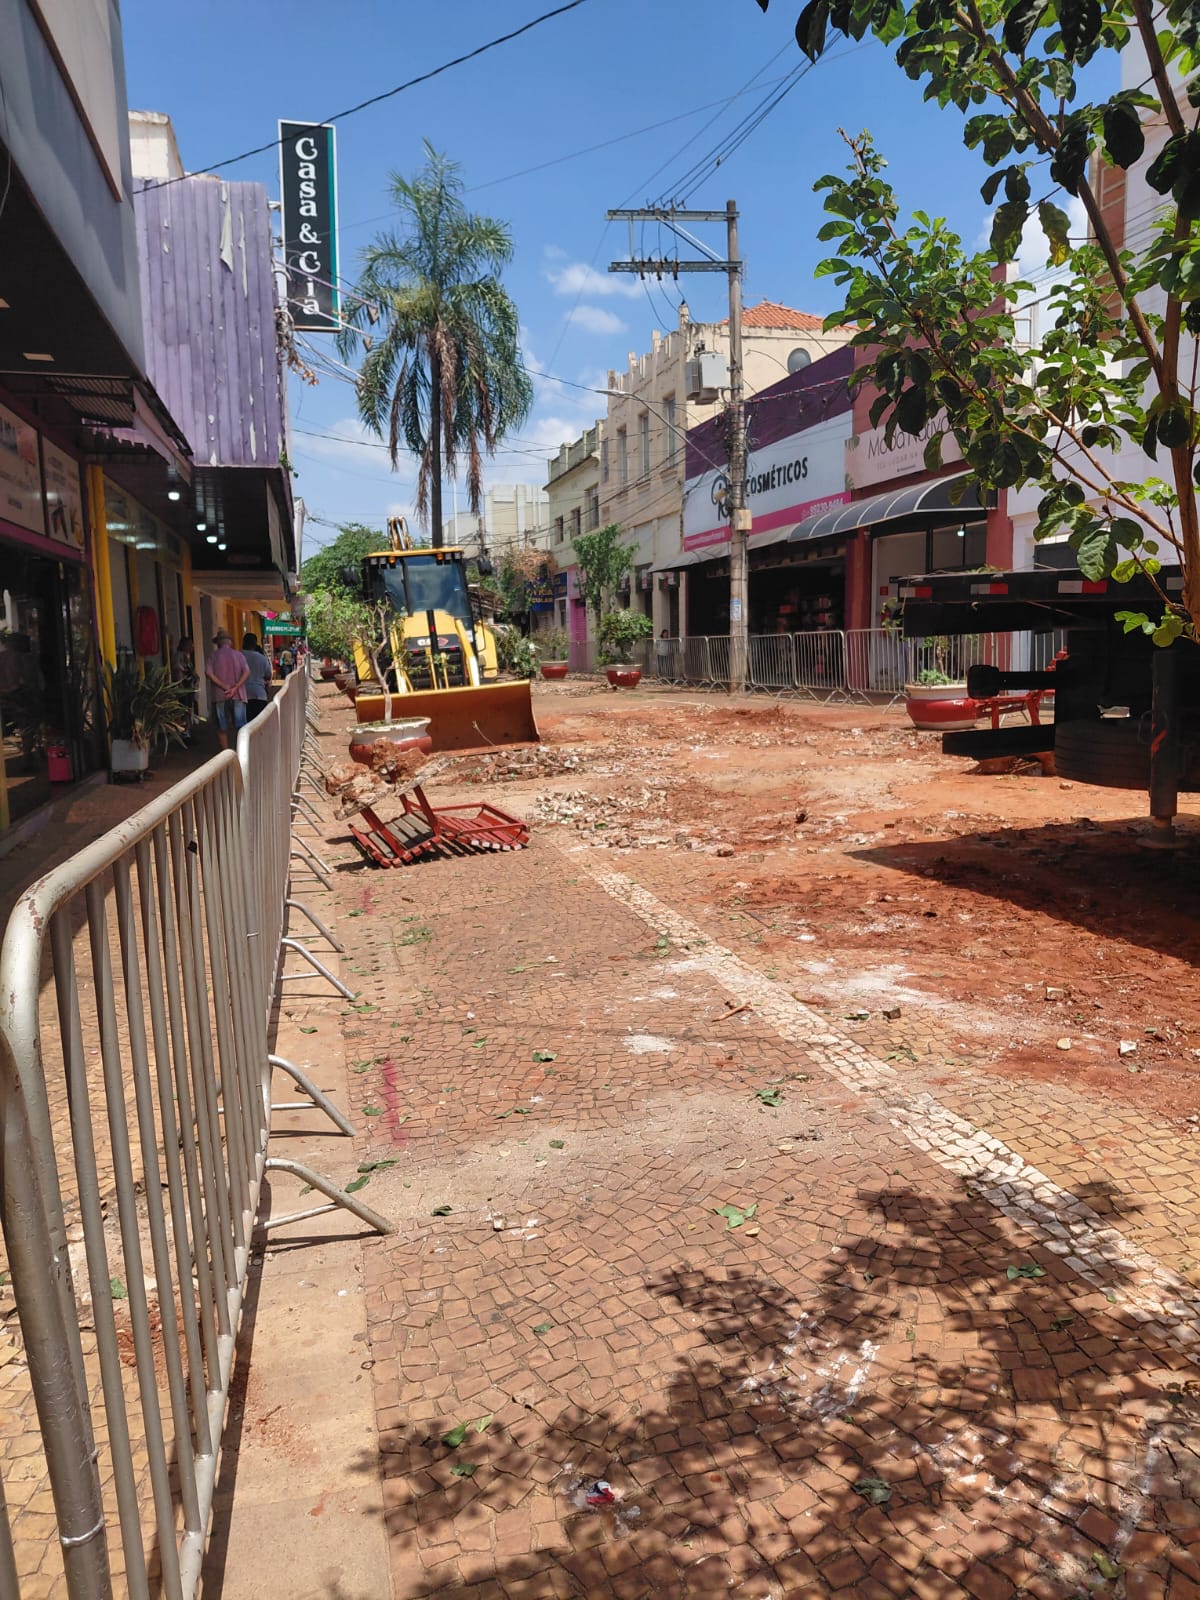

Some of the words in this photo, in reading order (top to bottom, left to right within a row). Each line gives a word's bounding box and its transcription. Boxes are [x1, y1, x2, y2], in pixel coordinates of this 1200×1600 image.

[295, 137, 318, 217] Casa
[299, 223, 322, 244] &
[299, 251, 321, 315] Cia
[745, 456, 808, 498] COSMÉTICOS
